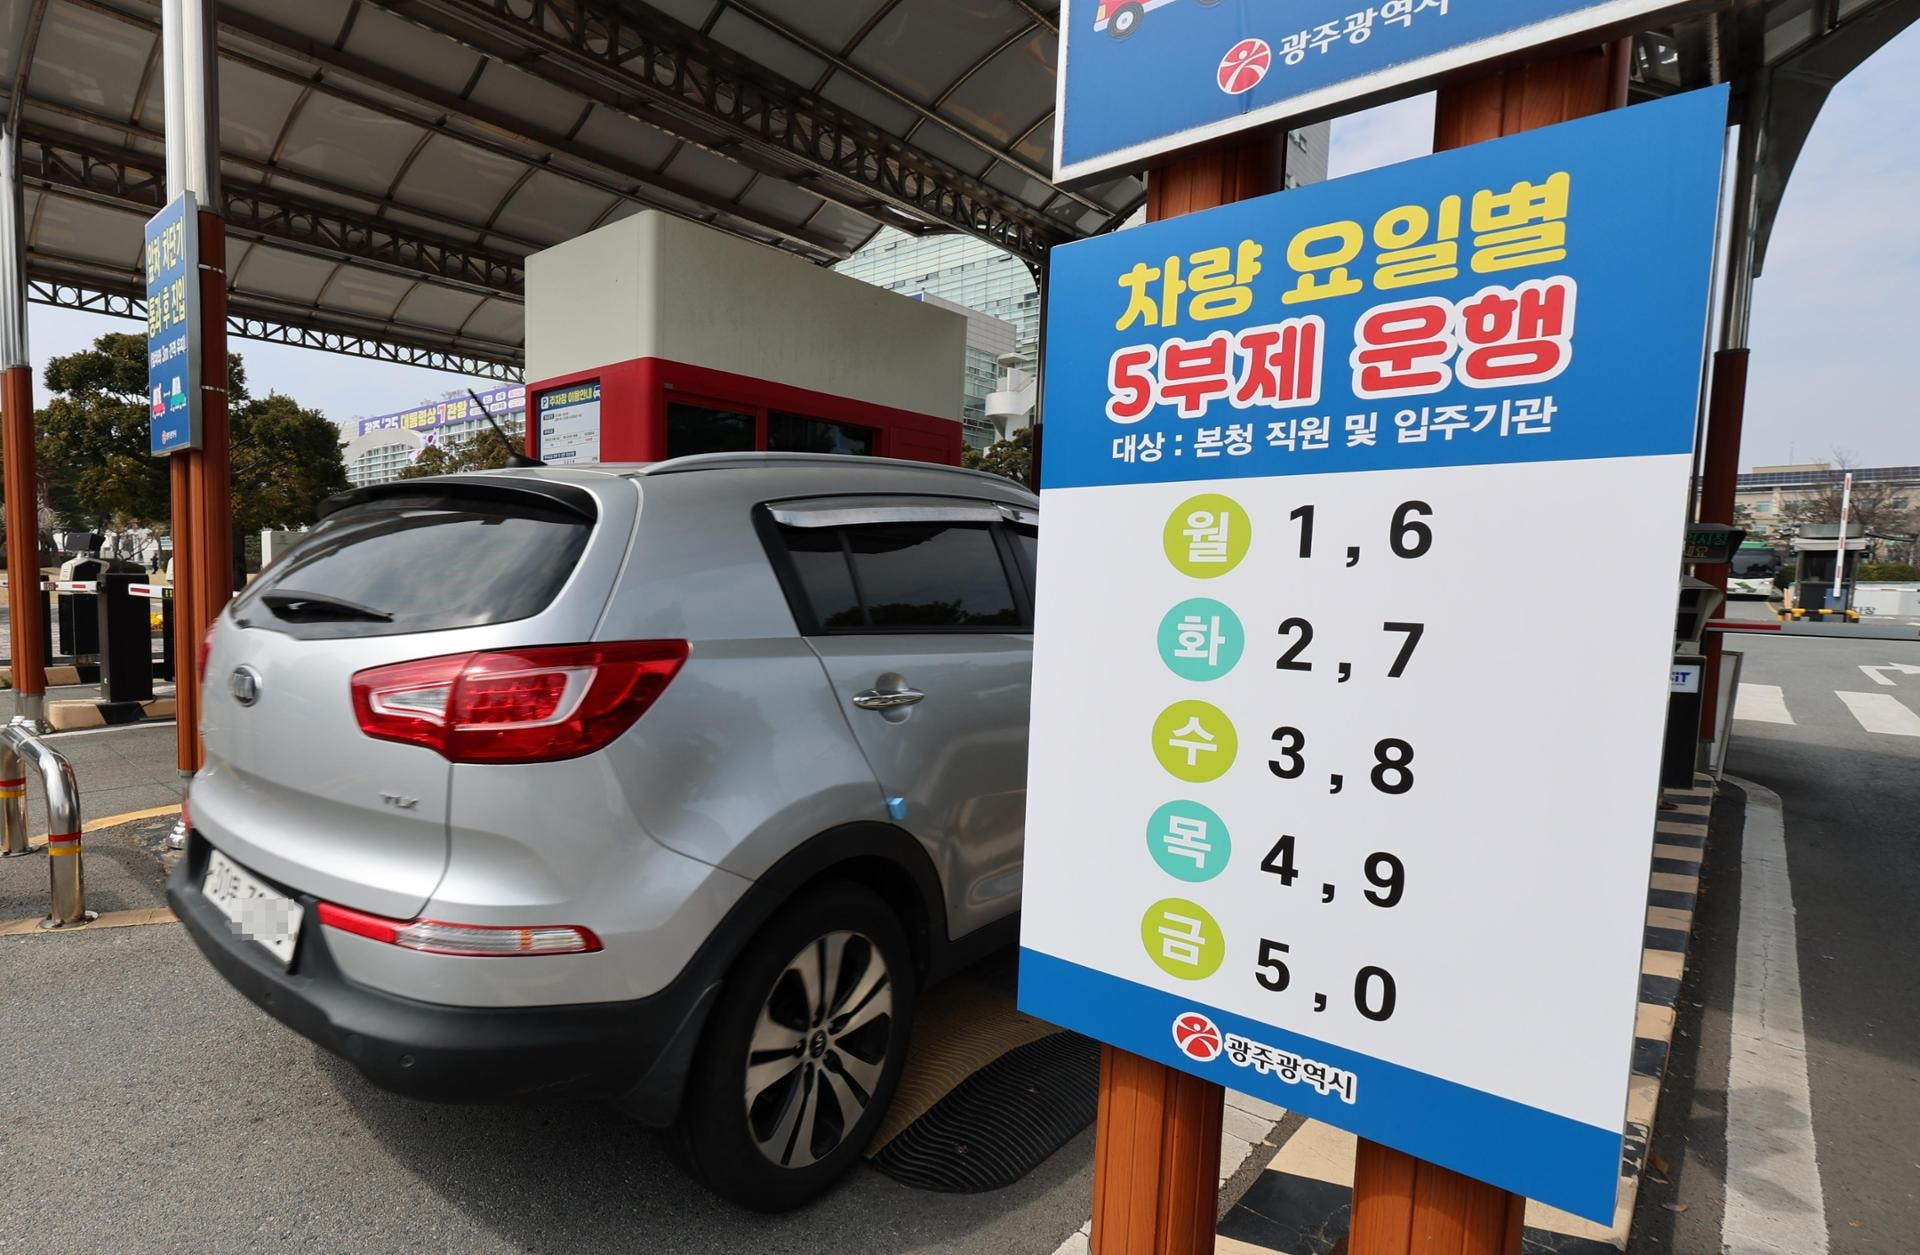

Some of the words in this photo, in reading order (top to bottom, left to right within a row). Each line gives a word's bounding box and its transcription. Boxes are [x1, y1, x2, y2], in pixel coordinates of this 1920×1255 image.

[163, 216, 184, 270] 차단기
[1115, 239, 1262, 331] 차량
[1281, 171, 1570, 304] 요일별
[148, 292, 162, 338] 통과
[163, 286, 170, 329] 후
[172, 276, 185, 324] 진입
[1105, 315, 1325, 424] 5부제
[1351, 275, 1577, 399] 운행
[1112, 432, 1166, 463] 대상
[1194, 424, 1254, 458] 본청
[1265, 417, 1330, 451] 직원
[1344, 412, 1378, 446] 및
[1394, 396, 1557, 443] 입주기관
[1183, 511, 1231, 563] 월
[1174, 615, 1225, 665] 화
[1168, 716, 1217, 765] 수
[1163, 815, 1212, 869] 목
[1158, 912, 1206, 966] 금
[1225, 1033, 1357, 1104] 광주광역시
